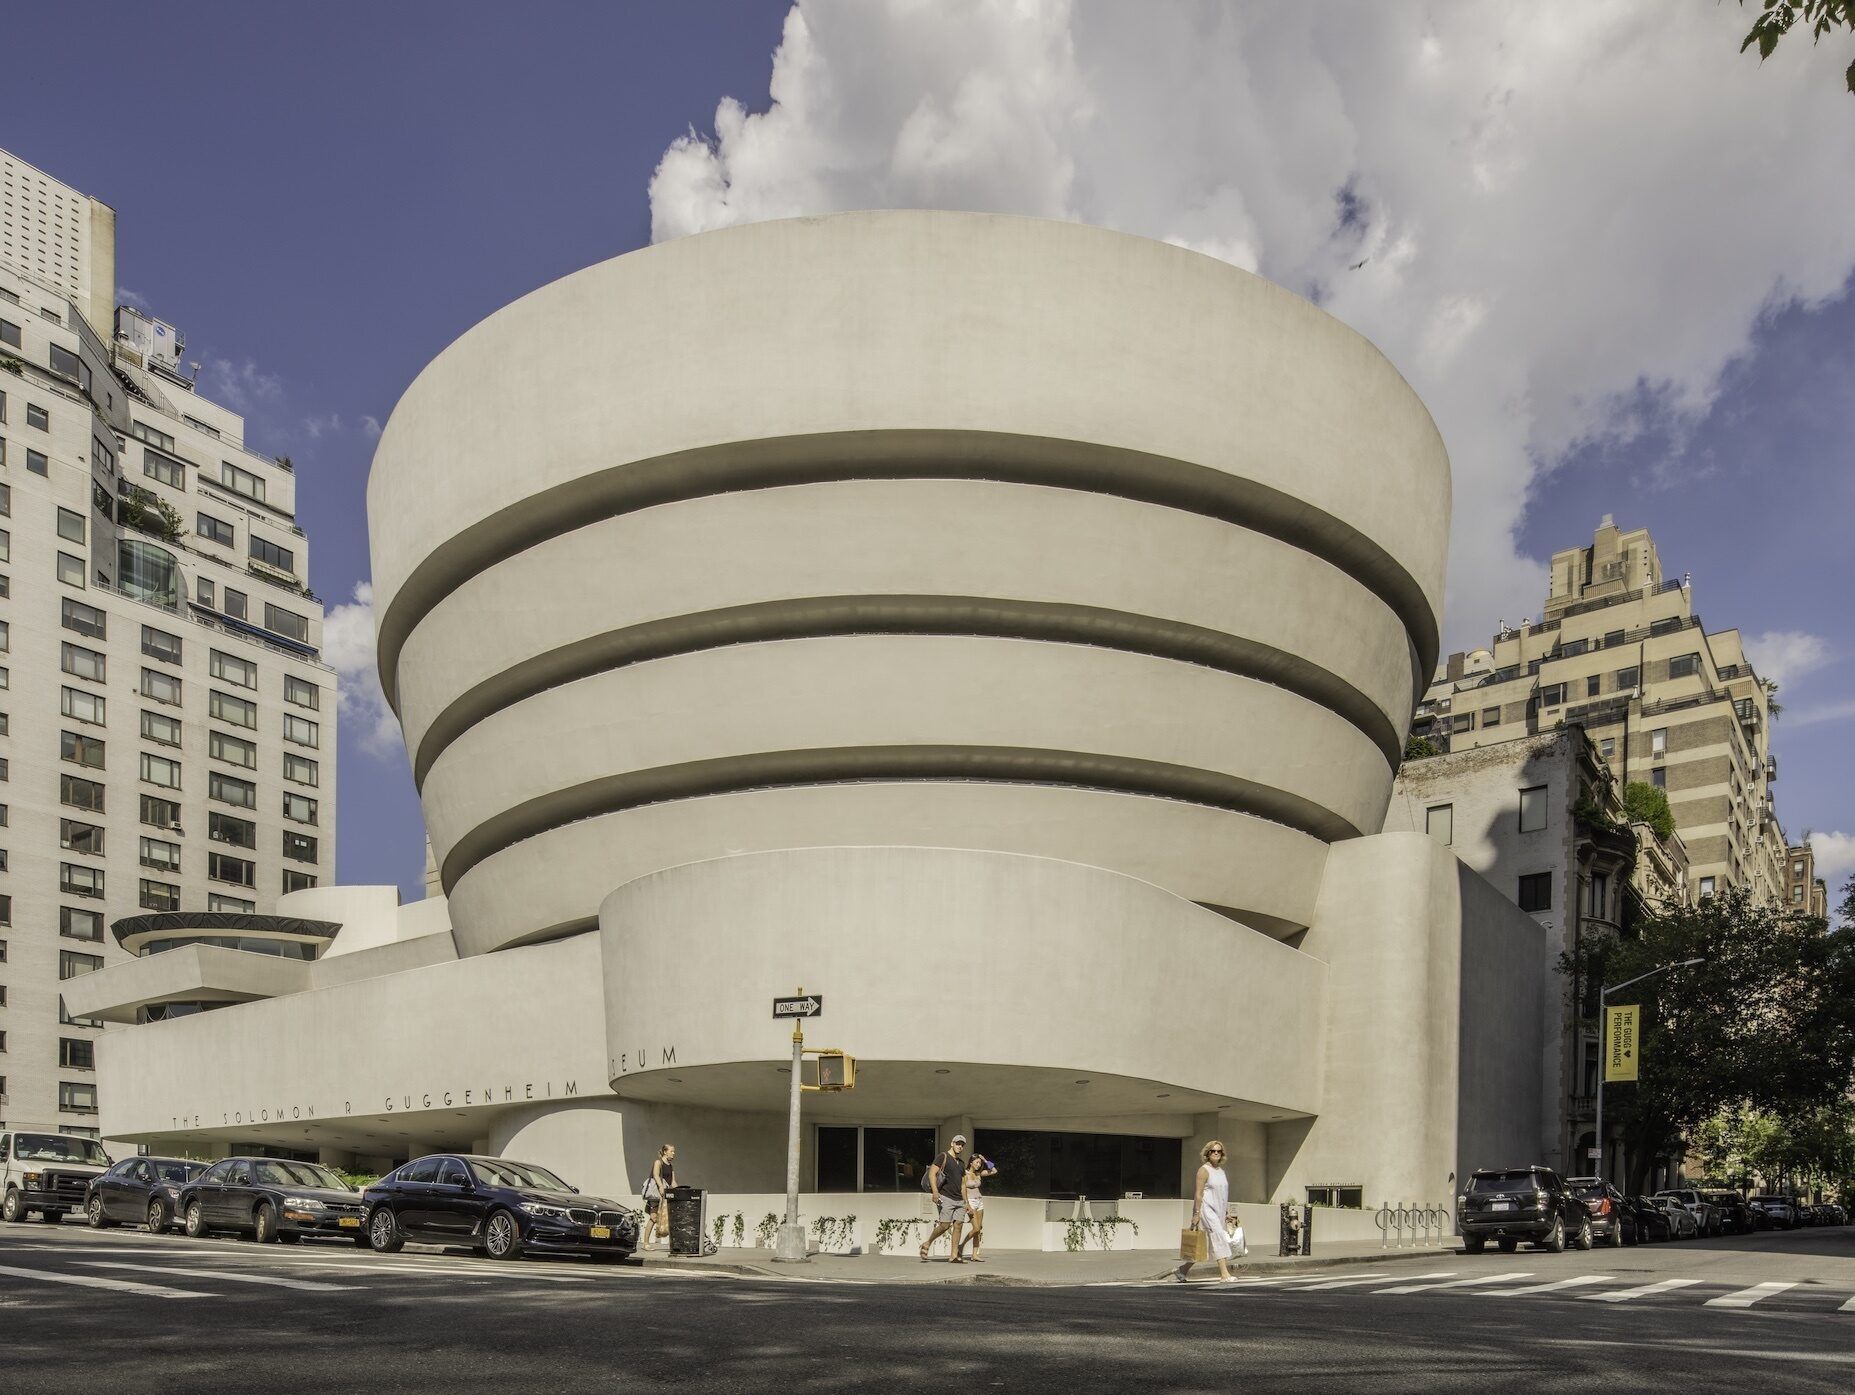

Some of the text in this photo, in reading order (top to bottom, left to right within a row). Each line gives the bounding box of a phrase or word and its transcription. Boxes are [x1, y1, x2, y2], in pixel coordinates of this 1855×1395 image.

[779, 1002, 814, 1012] ONE WAY
[1623, 1011, 1632, 1049] THE GUGG
[1613, 1012, 1622, 1068] PERFORMANCE
[172, 1045, 677, 1129] THE SOLOMON R GUGGENHEIM SEUM
